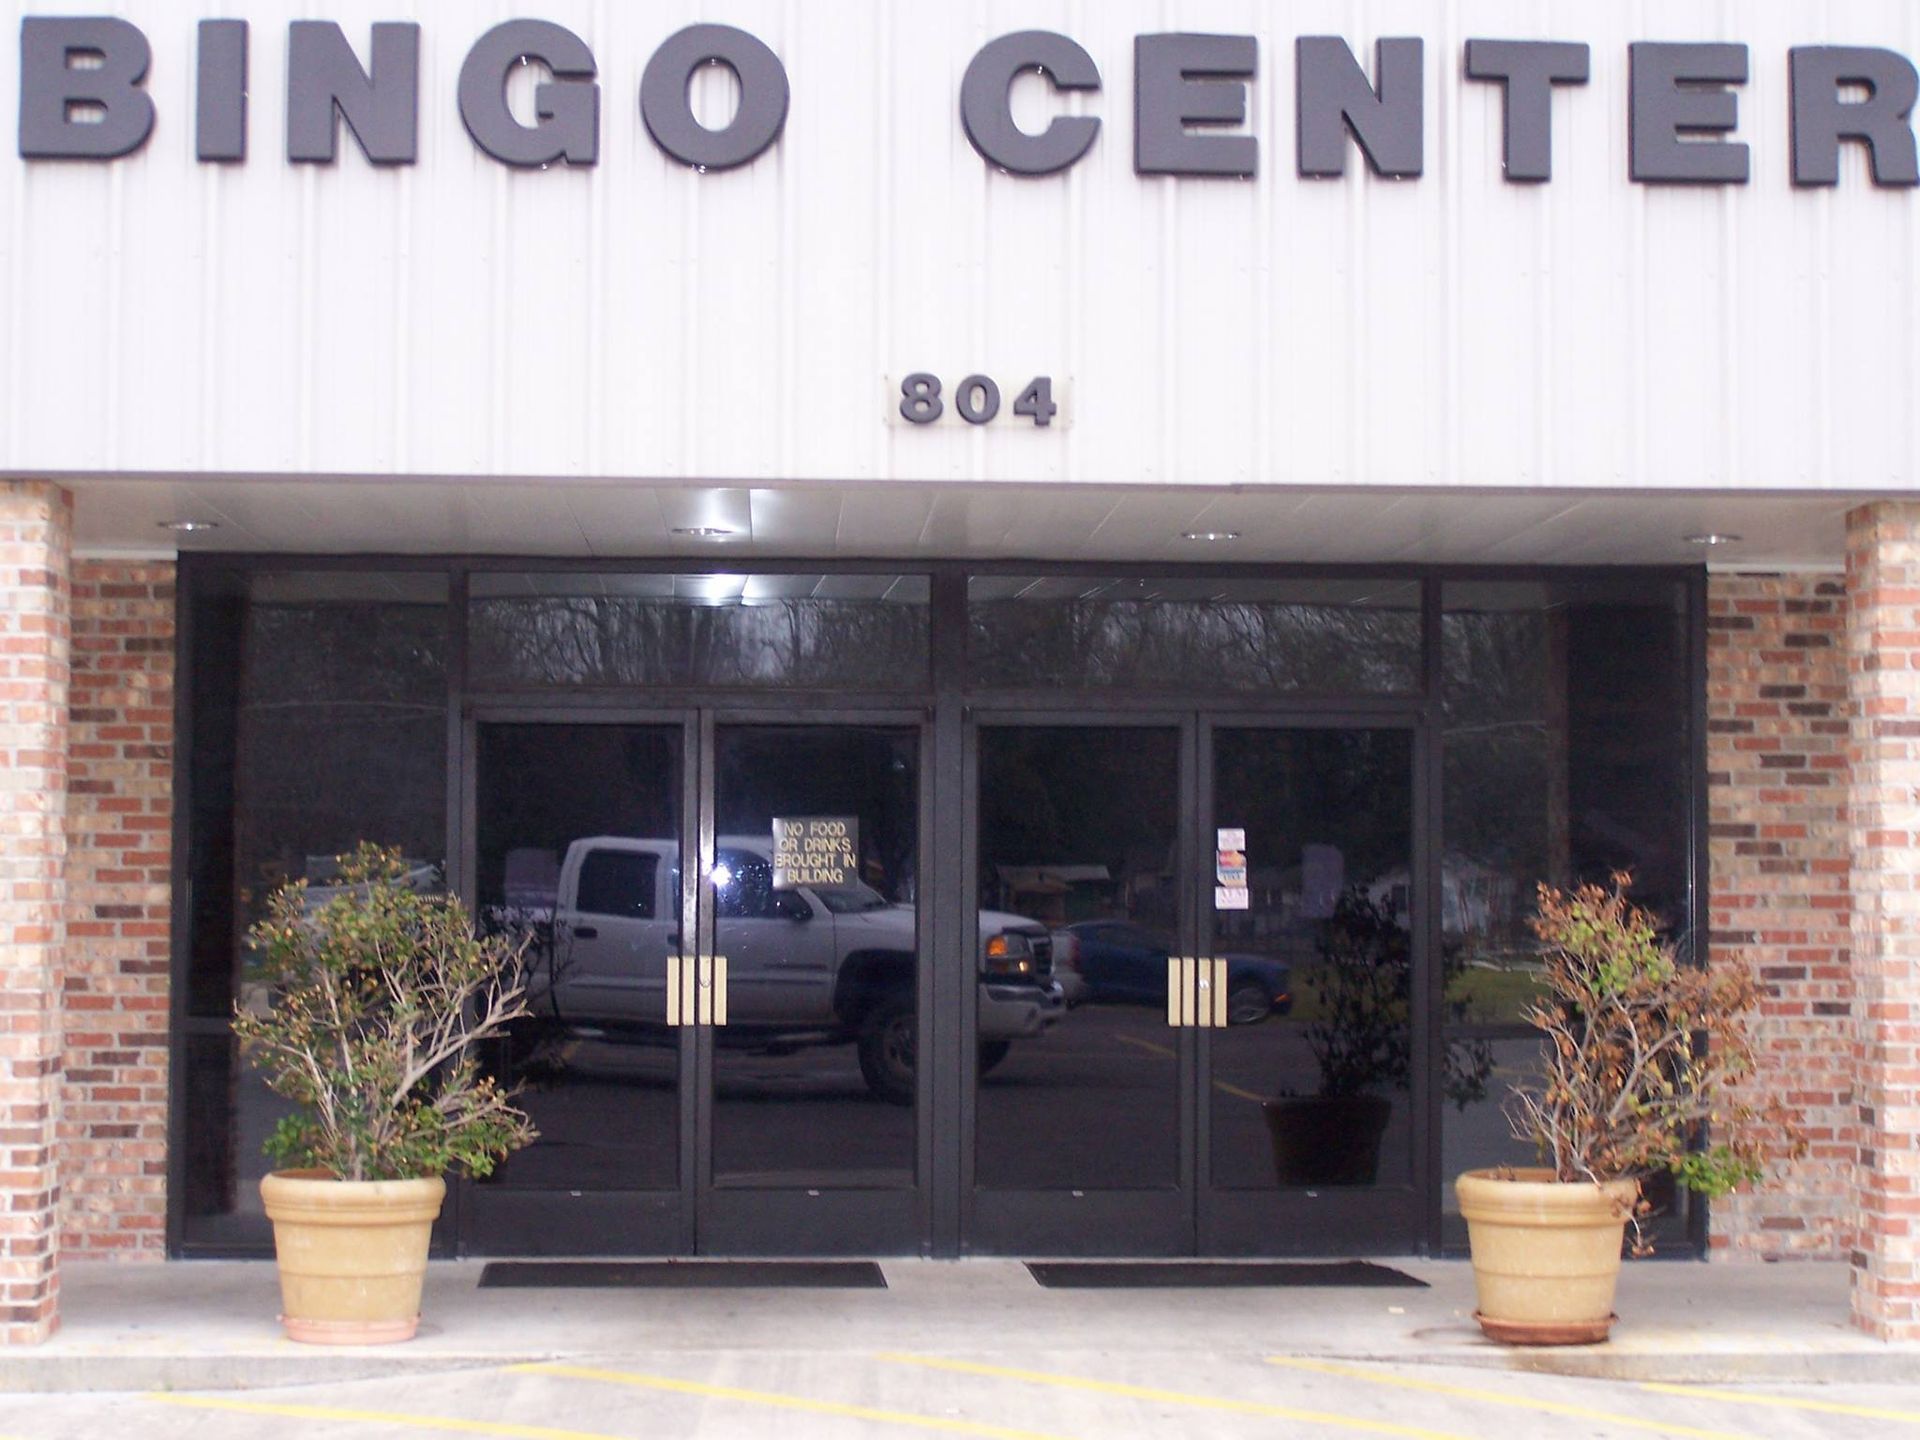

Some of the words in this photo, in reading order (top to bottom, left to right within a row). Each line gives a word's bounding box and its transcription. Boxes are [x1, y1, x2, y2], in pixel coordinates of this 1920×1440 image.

[19, 16, 791, 172] BINGO
[960, 29, 1920, 188] CENTER
[899, 372, 1057, 426] 804
[784, 822, 804, 836] NO
[810, 822, 846, 836] FOOD
[779, 837, 798, 852] OR
[804, 837, 852, 852] DRINKS
[774, 853, 835, 868] BROUGHT
[843, 853, 856, 868] IN
[787, 868, 844, 884] BUILDING
